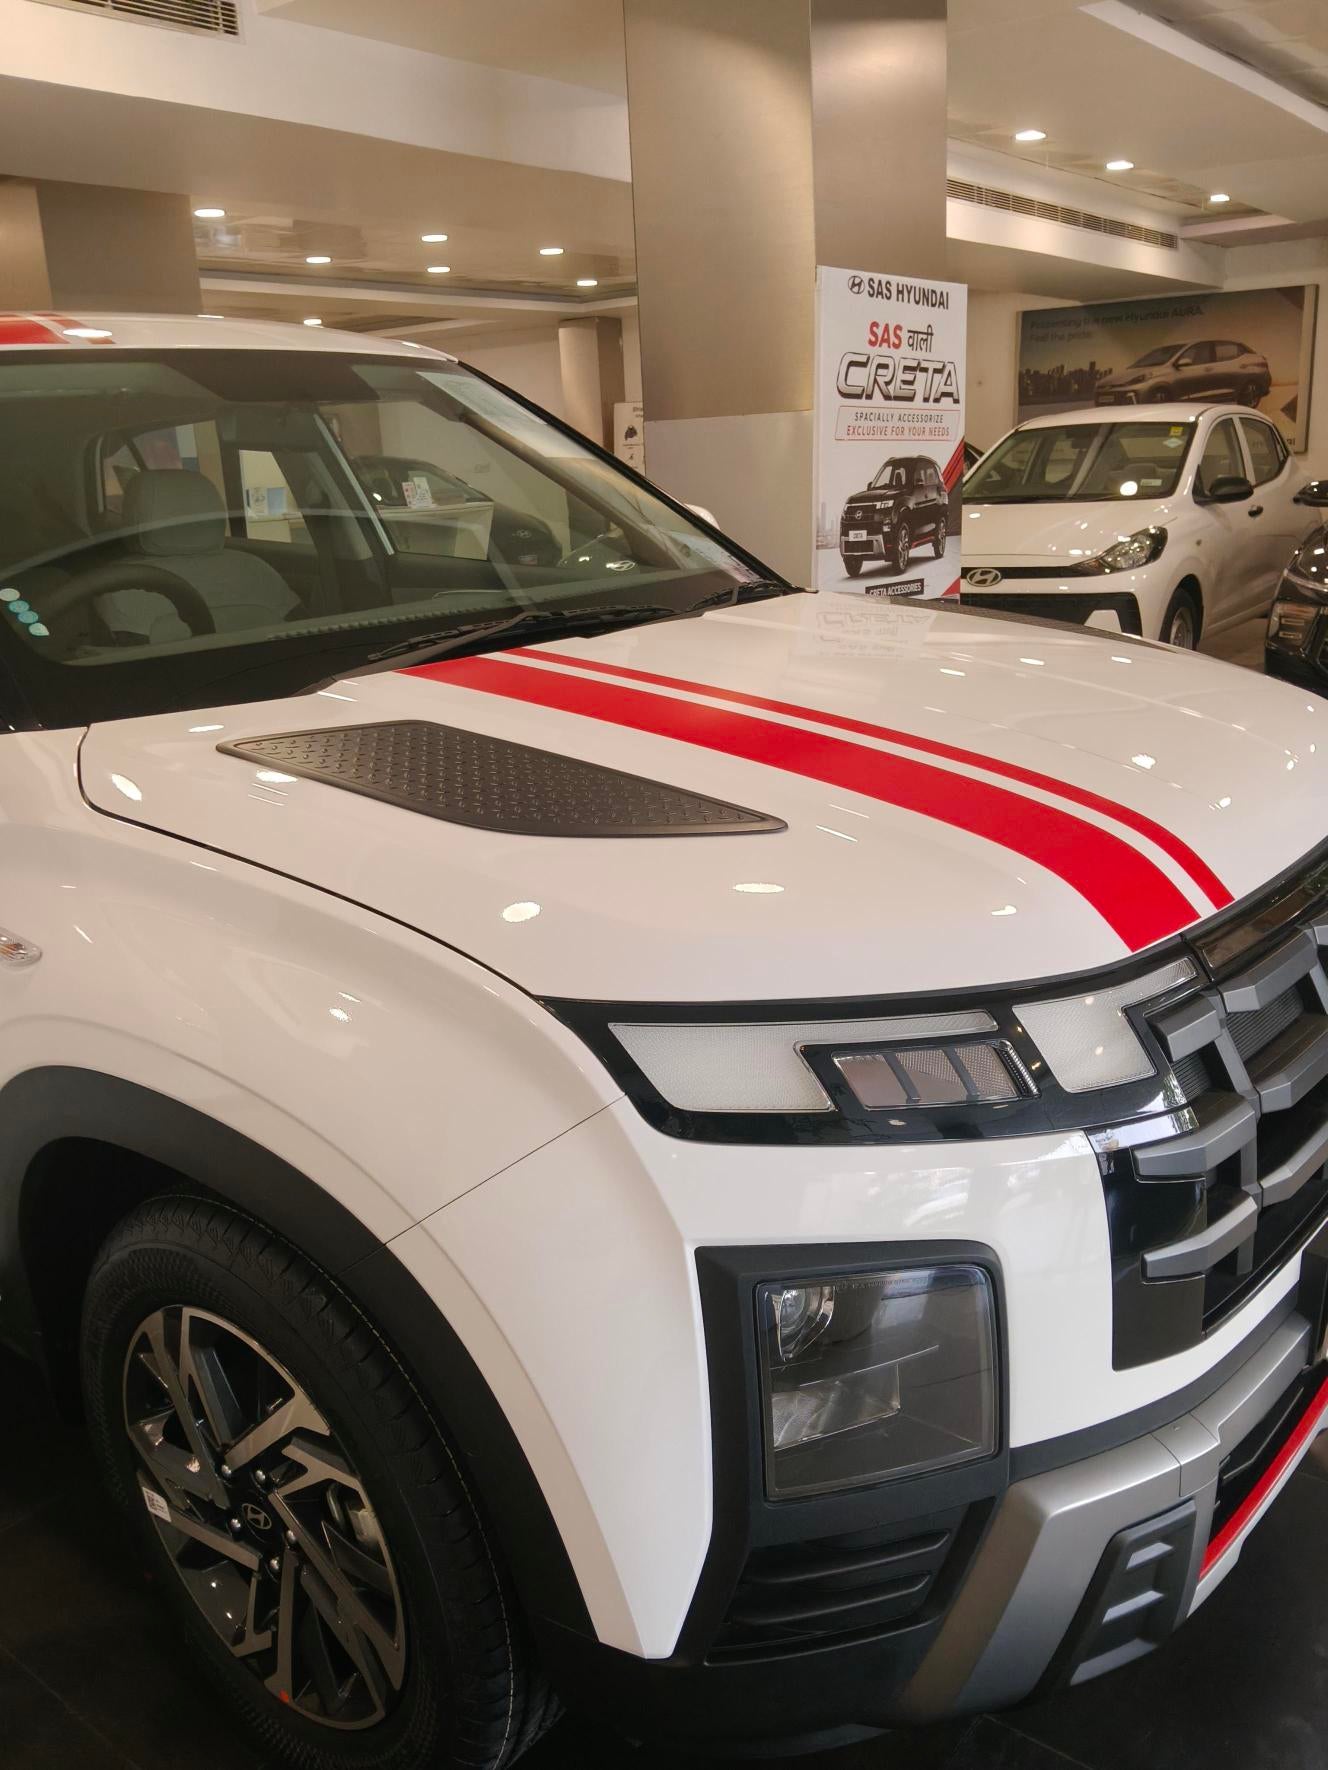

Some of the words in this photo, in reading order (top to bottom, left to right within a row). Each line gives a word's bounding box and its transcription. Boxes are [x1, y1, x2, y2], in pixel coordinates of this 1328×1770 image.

[867, 277, 892, 301] SAS
[896, 282, 949, 310] HYUNDAI
[867, 321, 903, 349] SAS
[907, 324, 934, 353] वाली
[836, 352, 960, 404] CRETA
[846, 425, 888, 436] EXCLUSIVE
[890, 426, 905, 437] FOR
[908, 426, 926, 437] YOUR
[928, 426, 950, 437] NEEDS
[854, 412, 895, 423] SPACIALLY
[898, 413, 944, 424] ACCESSORIZE
[887, 582, 922, 596] ACCESSORIES
